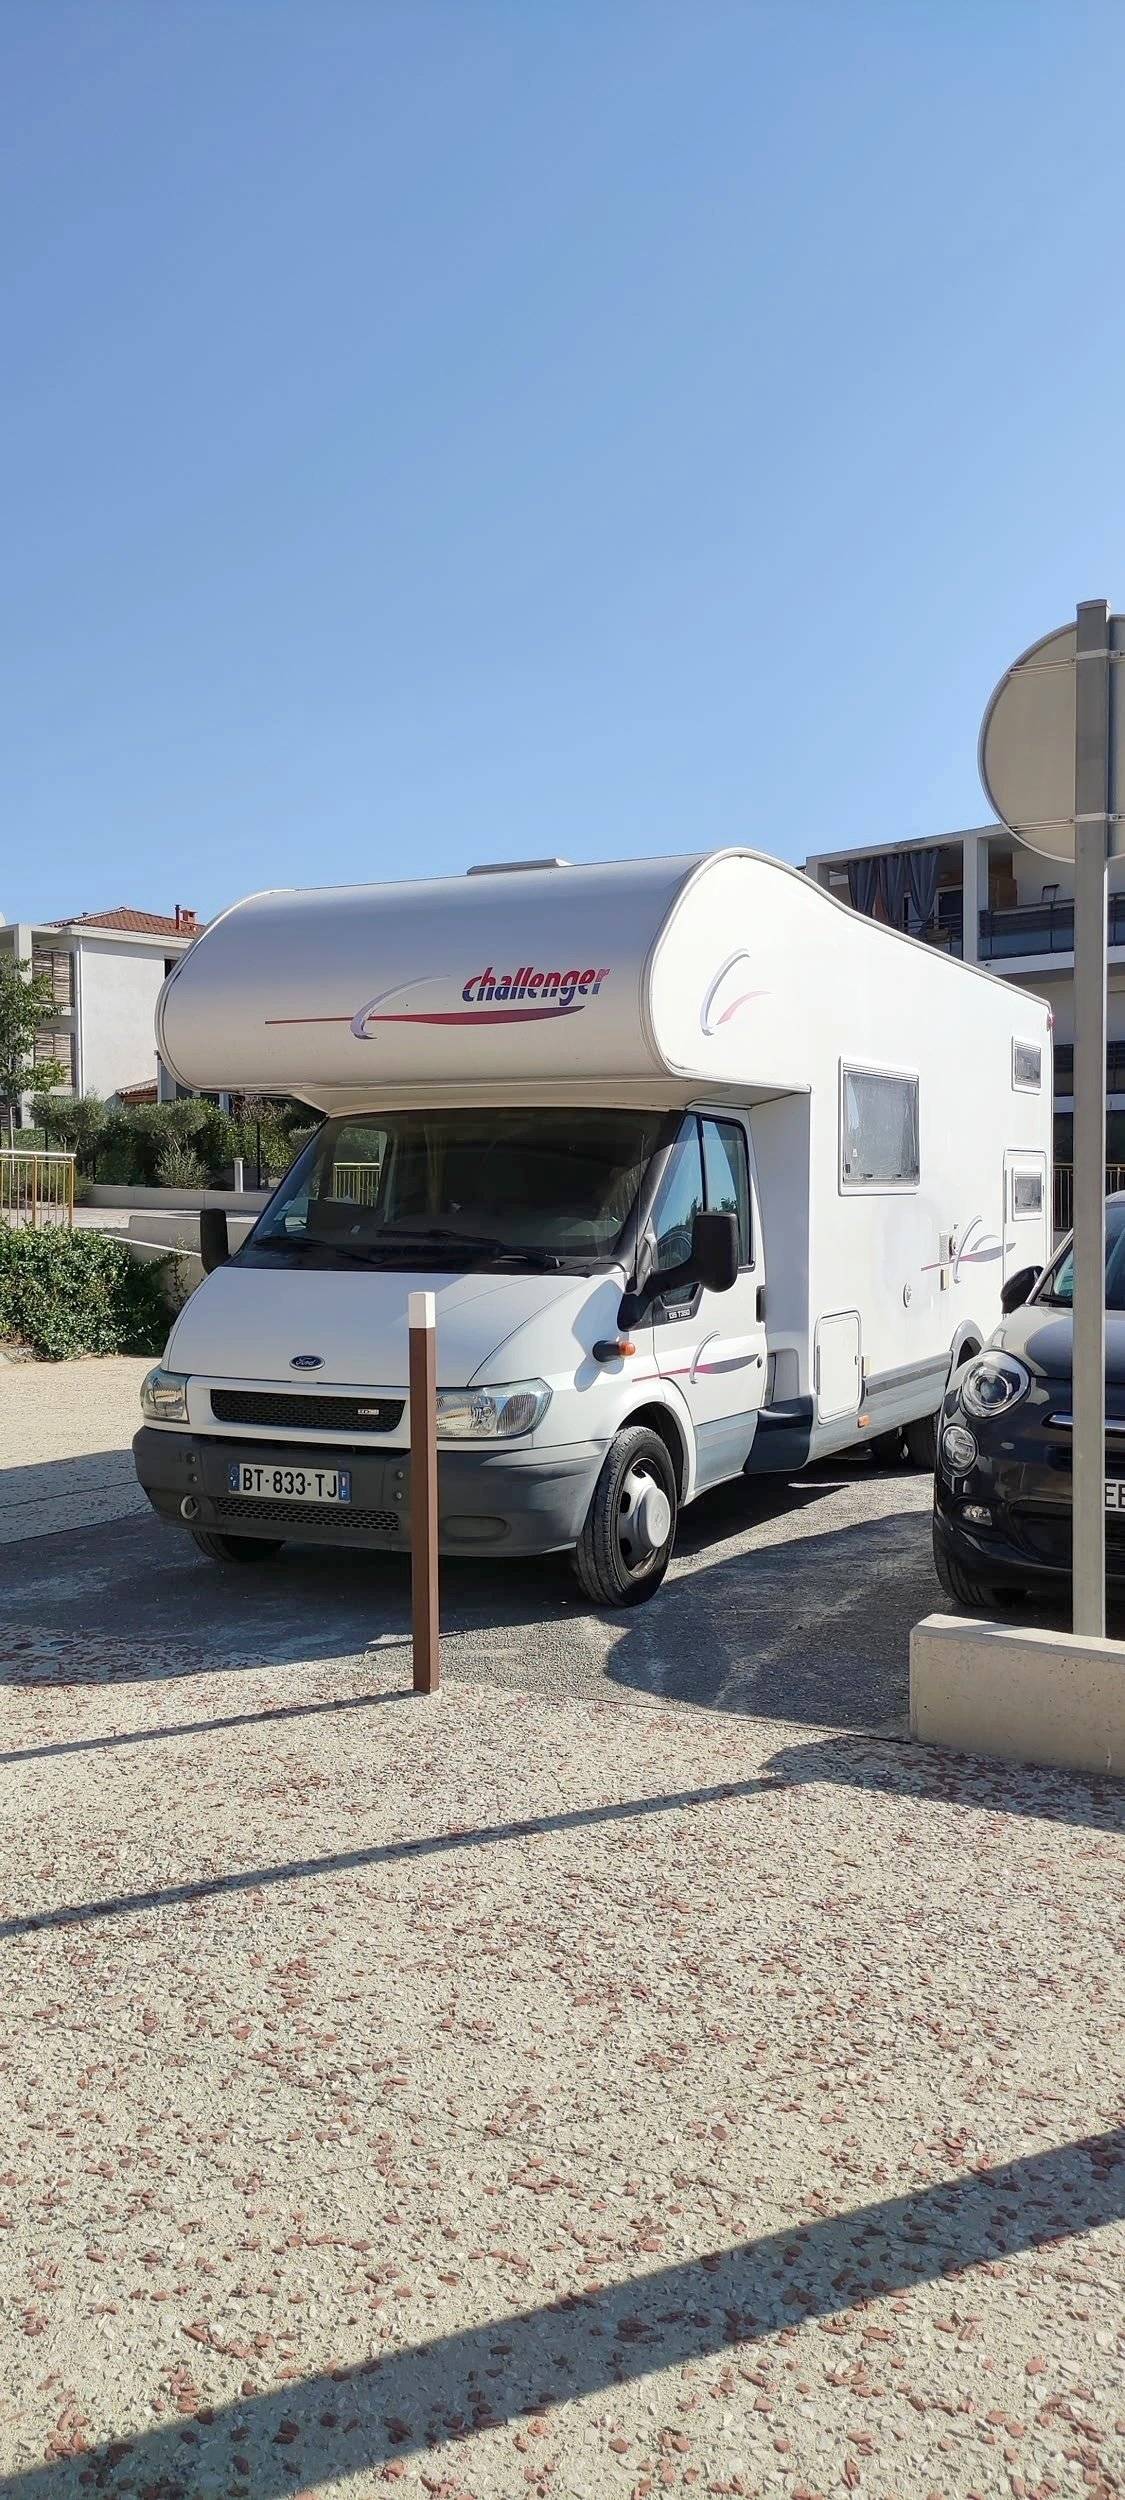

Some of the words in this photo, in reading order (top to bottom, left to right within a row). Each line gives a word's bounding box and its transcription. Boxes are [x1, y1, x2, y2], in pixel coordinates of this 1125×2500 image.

[462, 967, 610, 1007] challenger
[243, 1468, 338, 1498] BT-833-TJ
[341, 1490, 347, 1498] F
